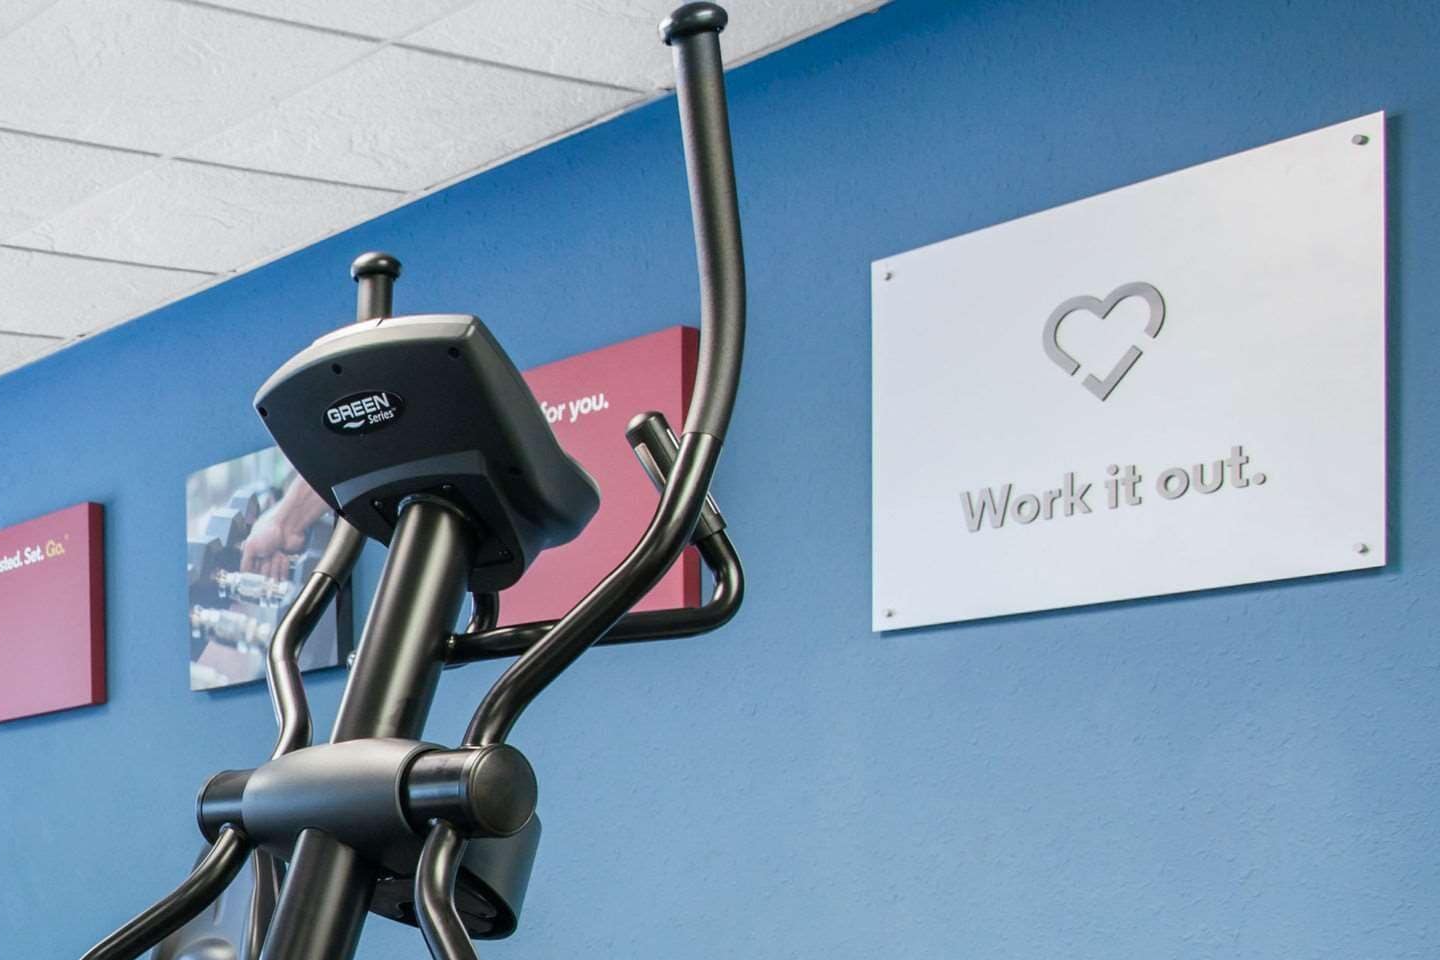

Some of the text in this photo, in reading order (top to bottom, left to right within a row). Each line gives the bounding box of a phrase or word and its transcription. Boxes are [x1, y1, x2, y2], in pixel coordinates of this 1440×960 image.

[326, 392, 390, 424] GREEN
[367, 410, 394, 424] Series
[569, 392, 609, 424] you.
[959, 446, 1267, 532] Work it out.
[23, 545, 45, 565] Set.
